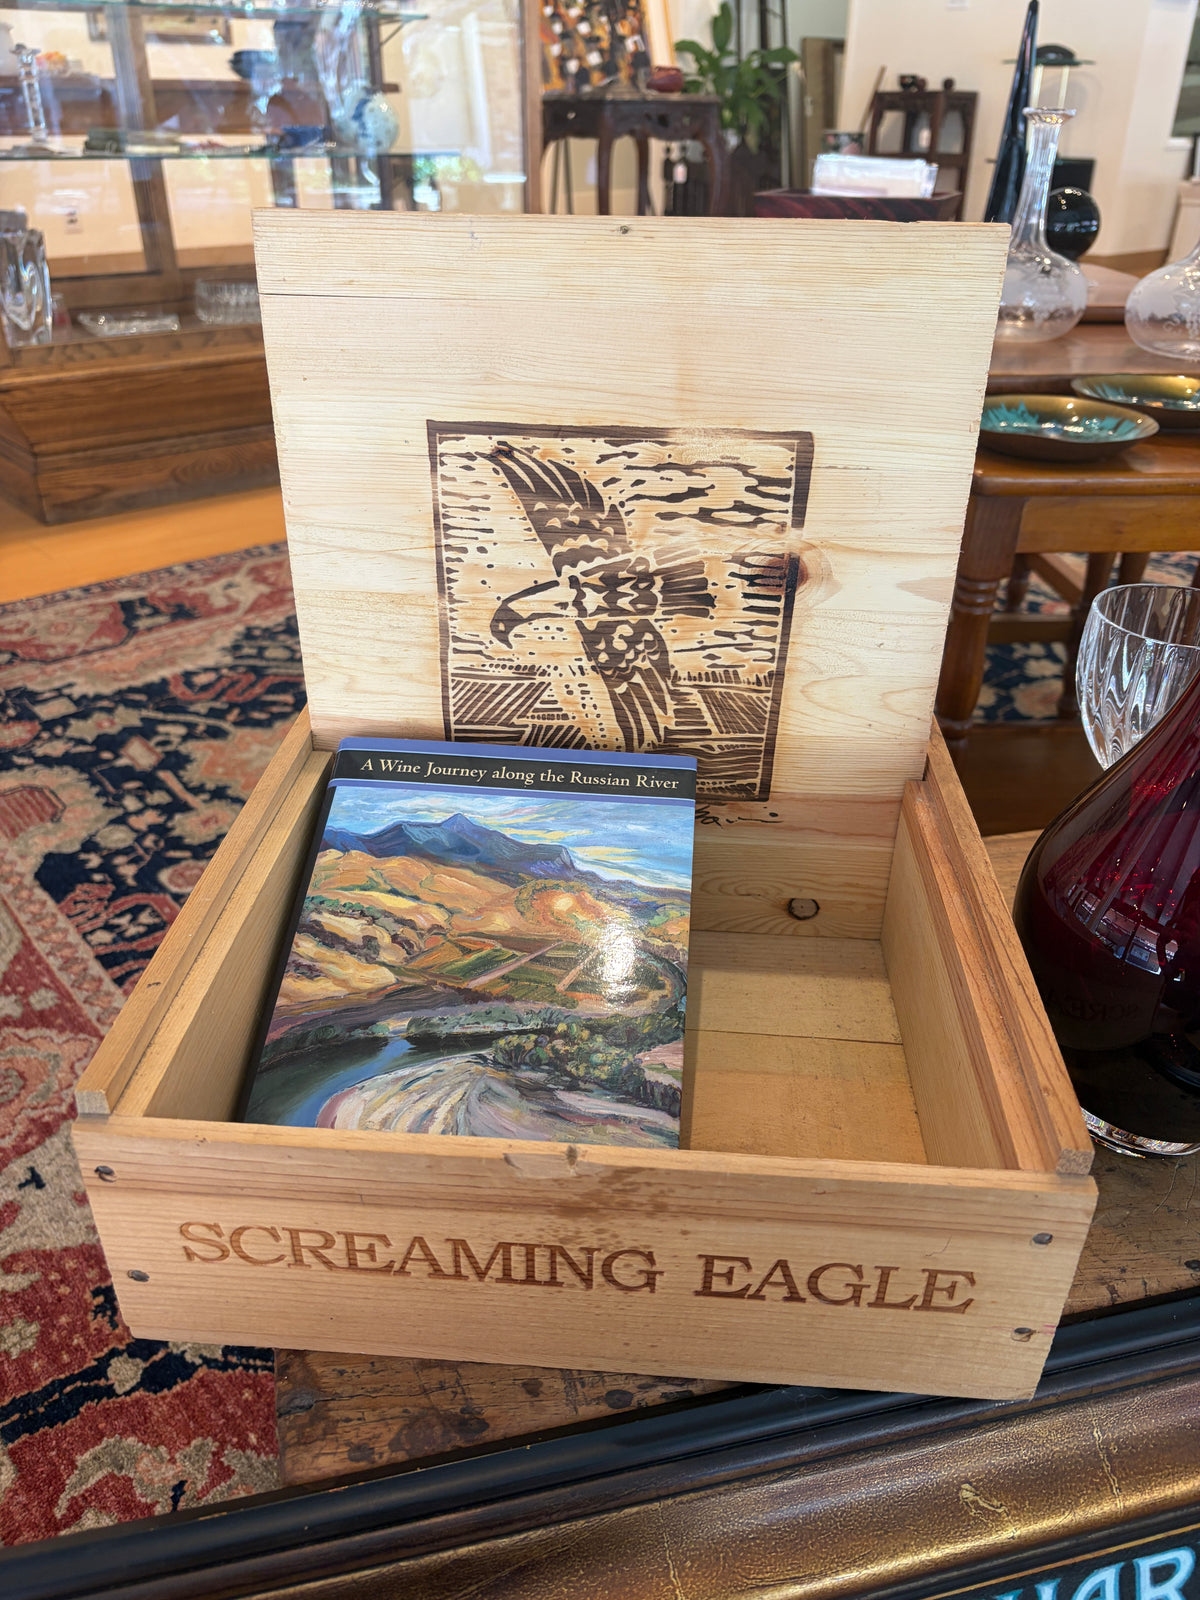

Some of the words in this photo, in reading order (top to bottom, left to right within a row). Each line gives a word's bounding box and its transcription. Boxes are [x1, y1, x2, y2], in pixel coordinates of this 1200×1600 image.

[360, 758, 374, 771] A
[379, 759, 421, 774] Wine
[423, 762, 487, 782] Journey
[492, 766, 535, 785] along
[540, 769, 565, 783] the
[570, 771, 630, 787] Russian
[636, 775, 679, 789] River
[179, 1221, 664, 1294] SCREAMING
[695, 1253, 976, 1314] EAGLE
